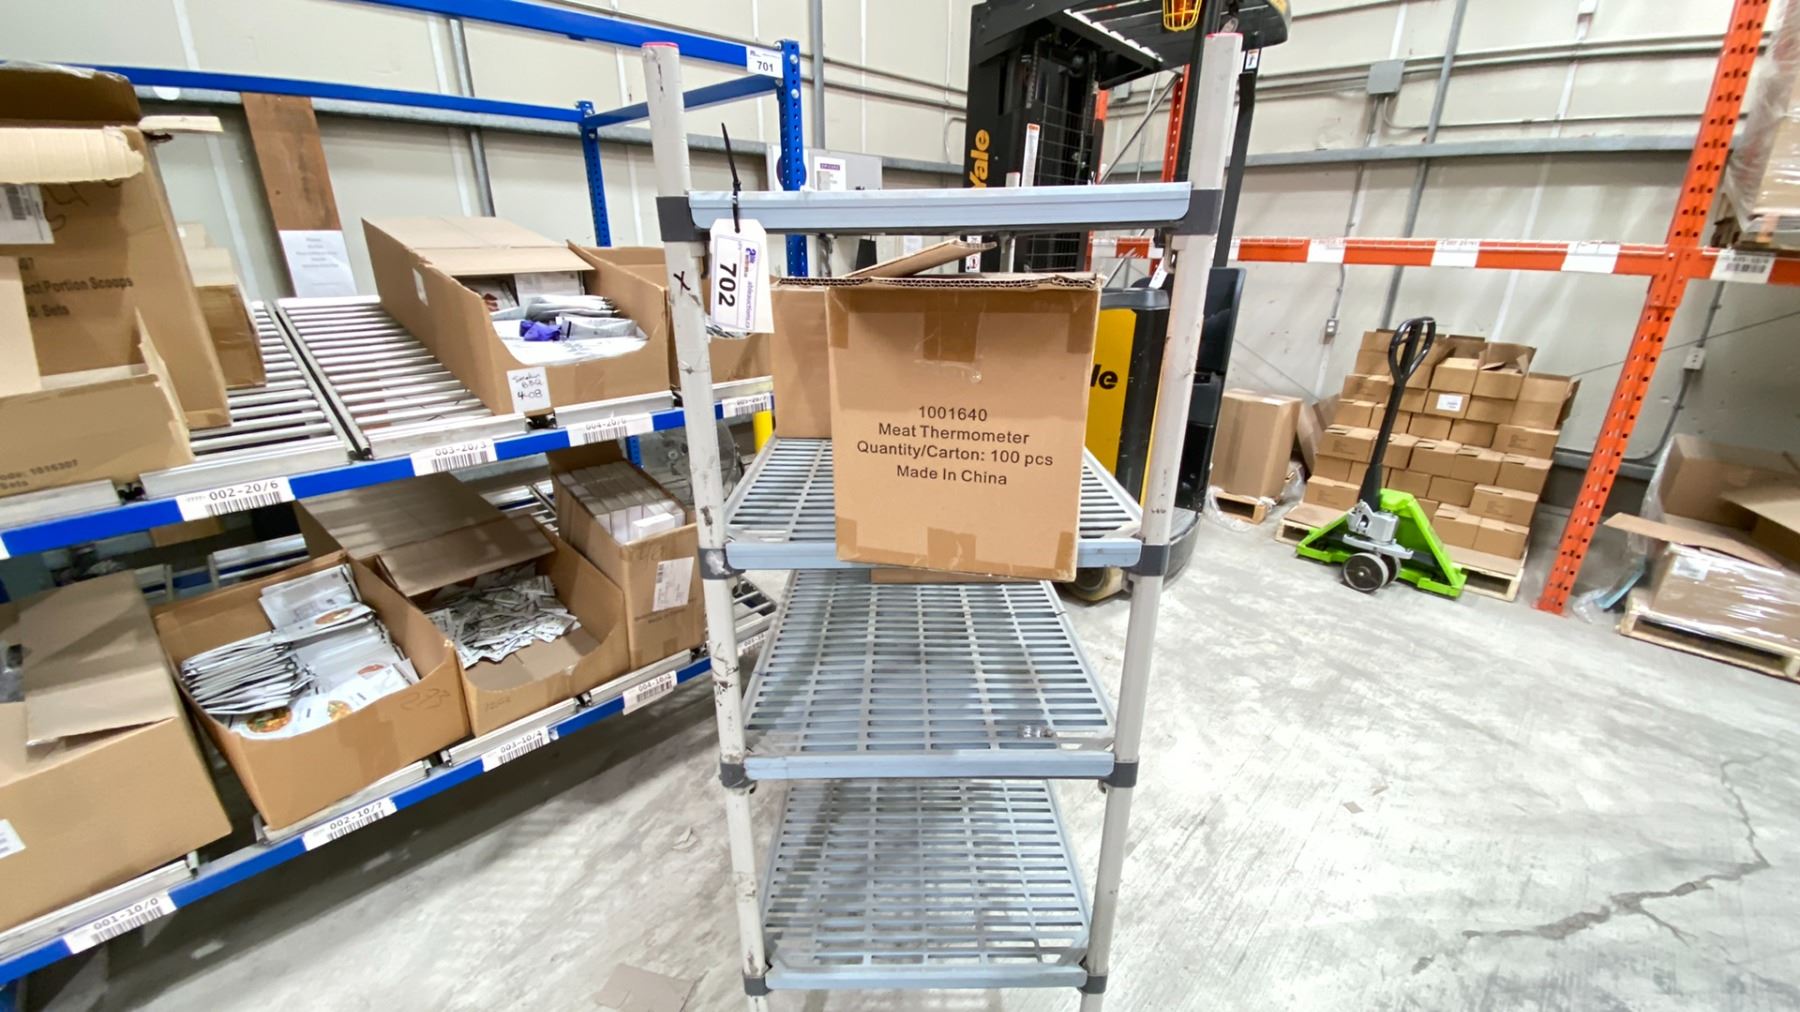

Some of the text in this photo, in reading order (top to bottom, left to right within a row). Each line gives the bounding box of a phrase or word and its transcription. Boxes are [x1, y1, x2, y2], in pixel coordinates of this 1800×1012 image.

[756, 60, 774, 73] 701
[89, 276, 134, 290] Scoops
[718, 263, 737, 307] 702
[1090, 363, 1119, 390] le
[918, 405, 988, 422] 1001640
[878, 422, 1030, 445] Meat Thermometer
[856, 440, 1054, 467] Quantity/Carton: 100 pcs
[896, 465, 1008, 485] Made In China
[209, 480, 279, 501] 002-20/6
[329, 802, 382, 830] 002-10/7
[93, 897, 159, 930] 001-10/0
